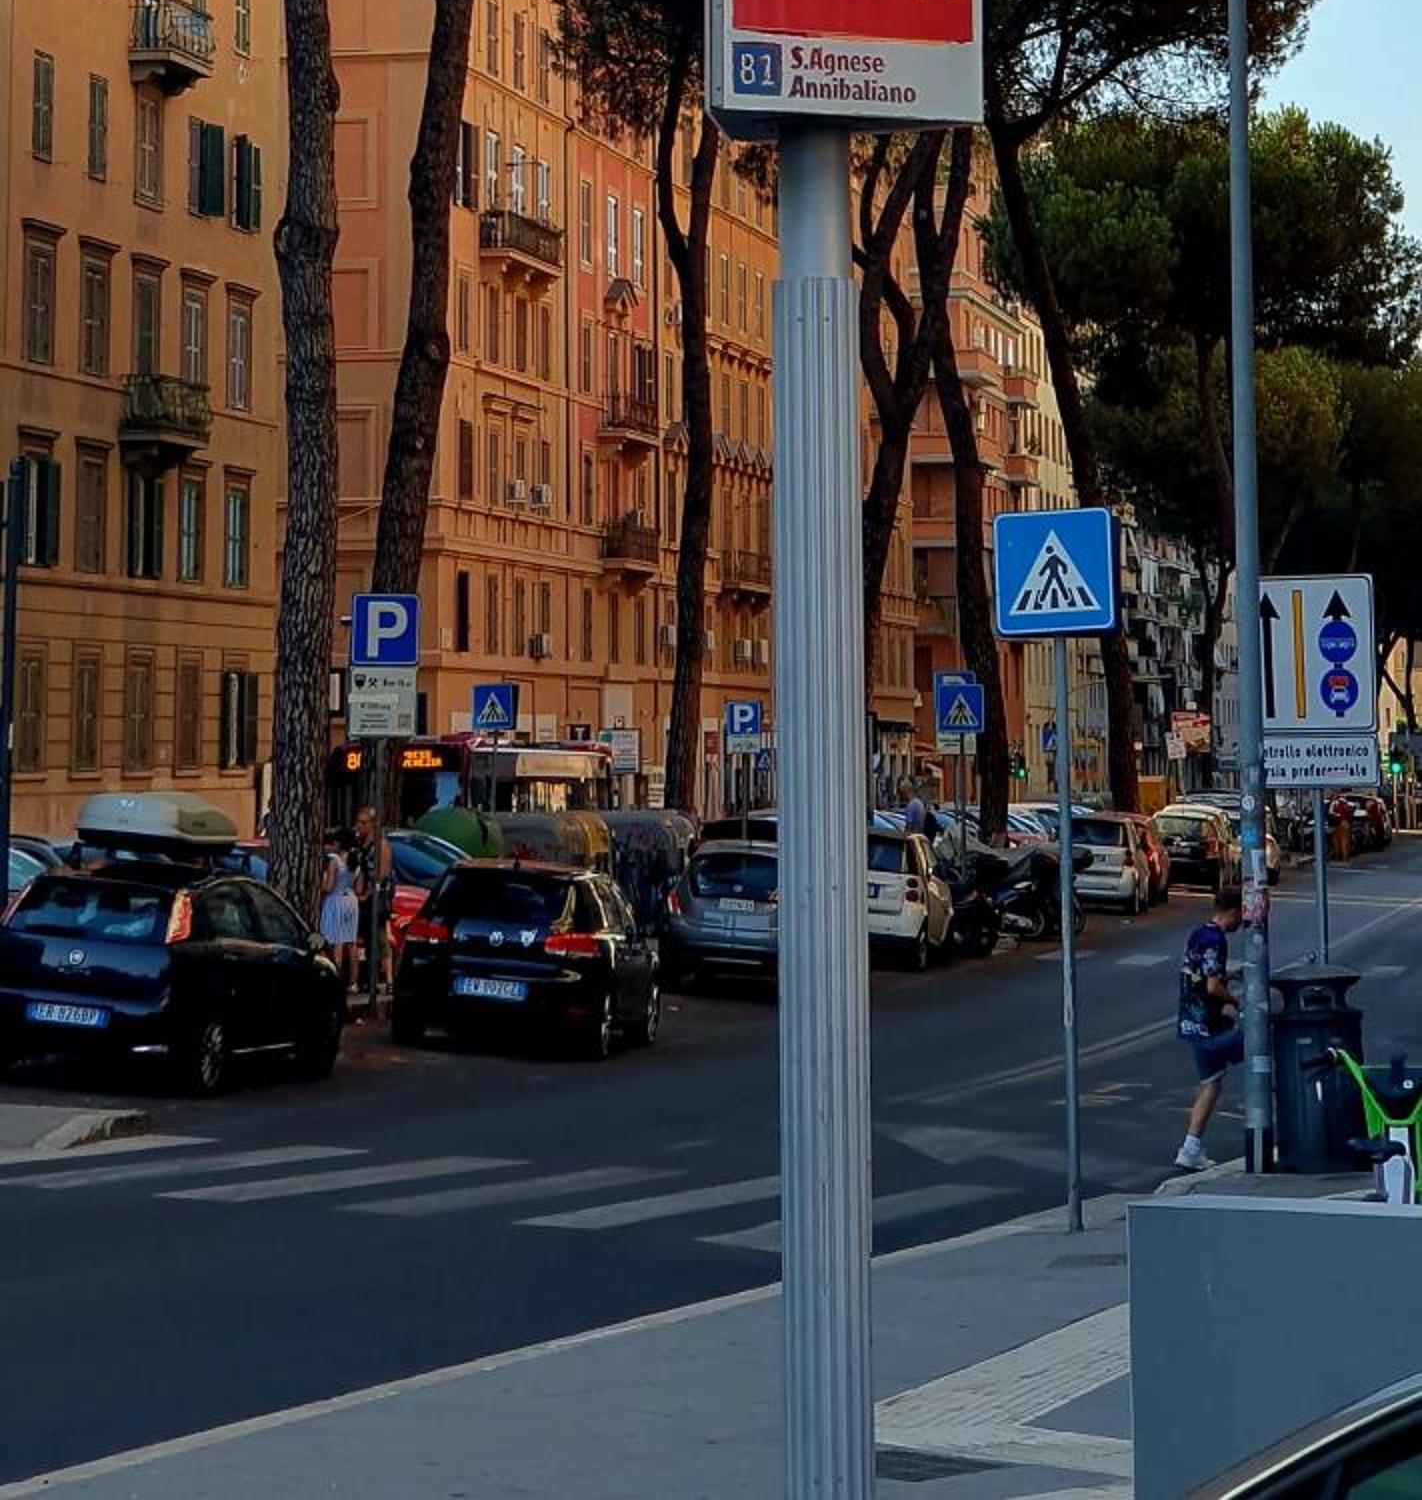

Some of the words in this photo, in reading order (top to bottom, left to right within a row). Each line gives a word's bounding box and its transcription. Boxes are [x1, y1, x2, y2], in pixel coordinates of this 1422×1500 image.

[790, 46, 886, 76] S.Agnese
[788, 75, 917, 104] Annibaliano
[367, 601, 408, 658] P
[733, 704, 754, 732] P
[1264, 744, 1301, 759] ntrollo
[1306, 744, 1369, 757] elettronico
